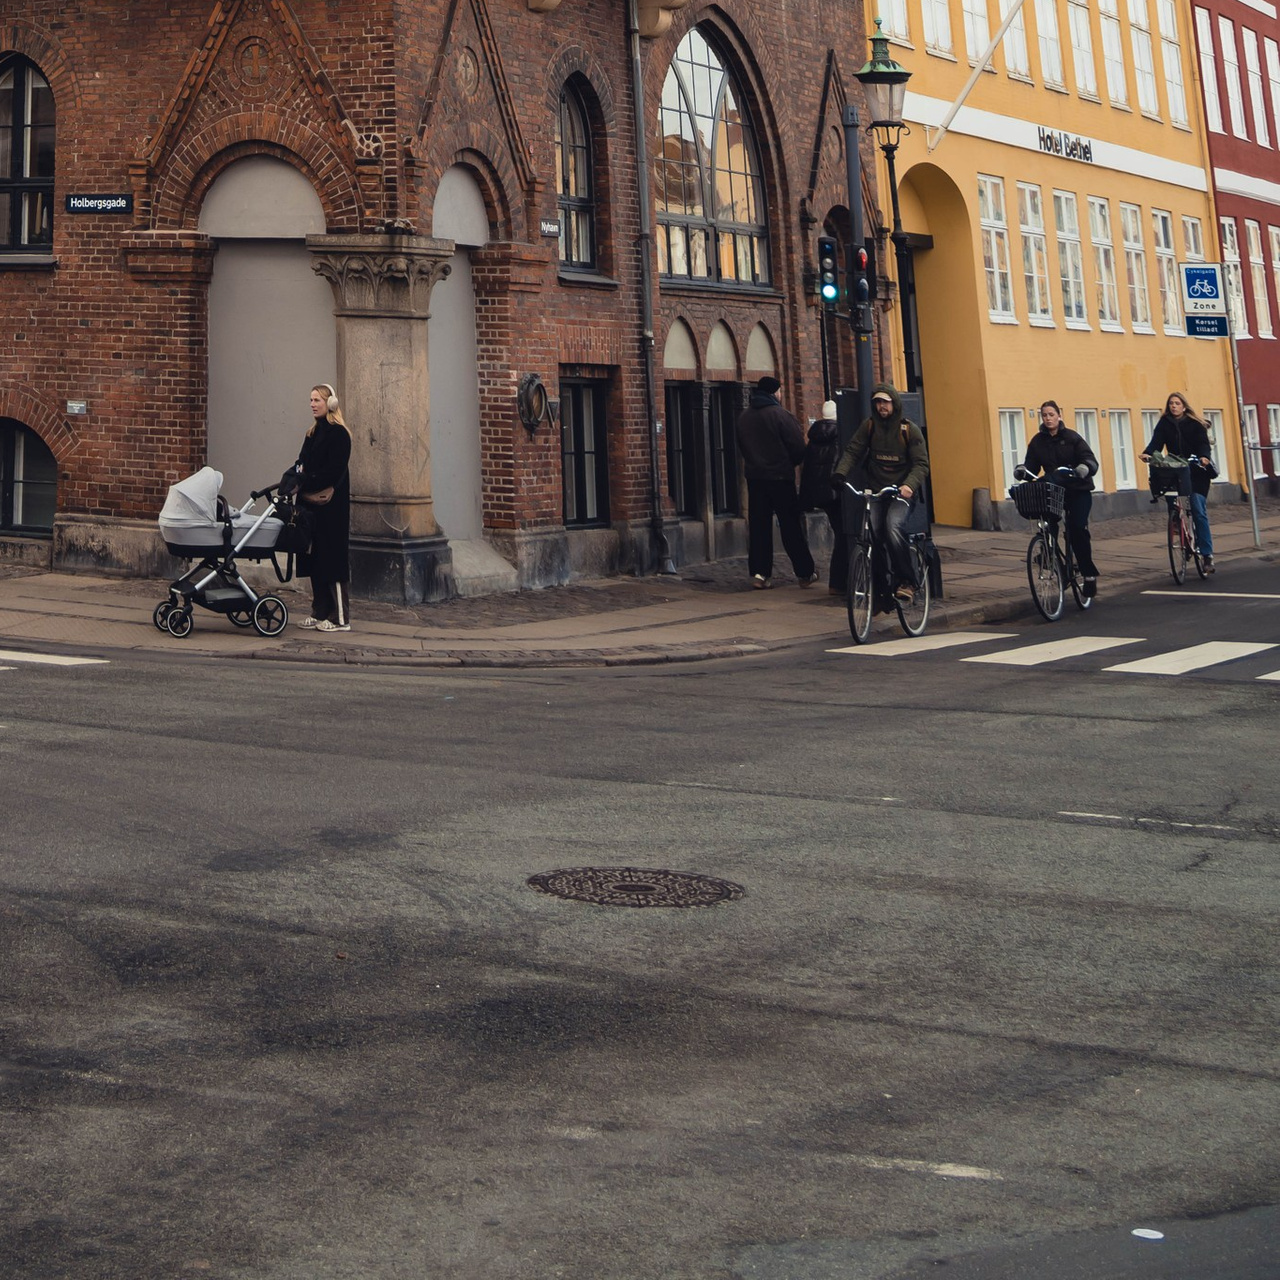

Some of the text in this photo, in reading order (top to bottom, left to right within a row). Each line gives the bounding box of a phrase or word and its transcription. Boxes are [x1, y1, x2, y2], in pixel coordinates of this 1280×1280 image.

[1037, 126, 1093, 163] Hotel Bethel
[70, 197, 126, 210] Holbergsgade
[1193, 302, 1216, 310] Zone
